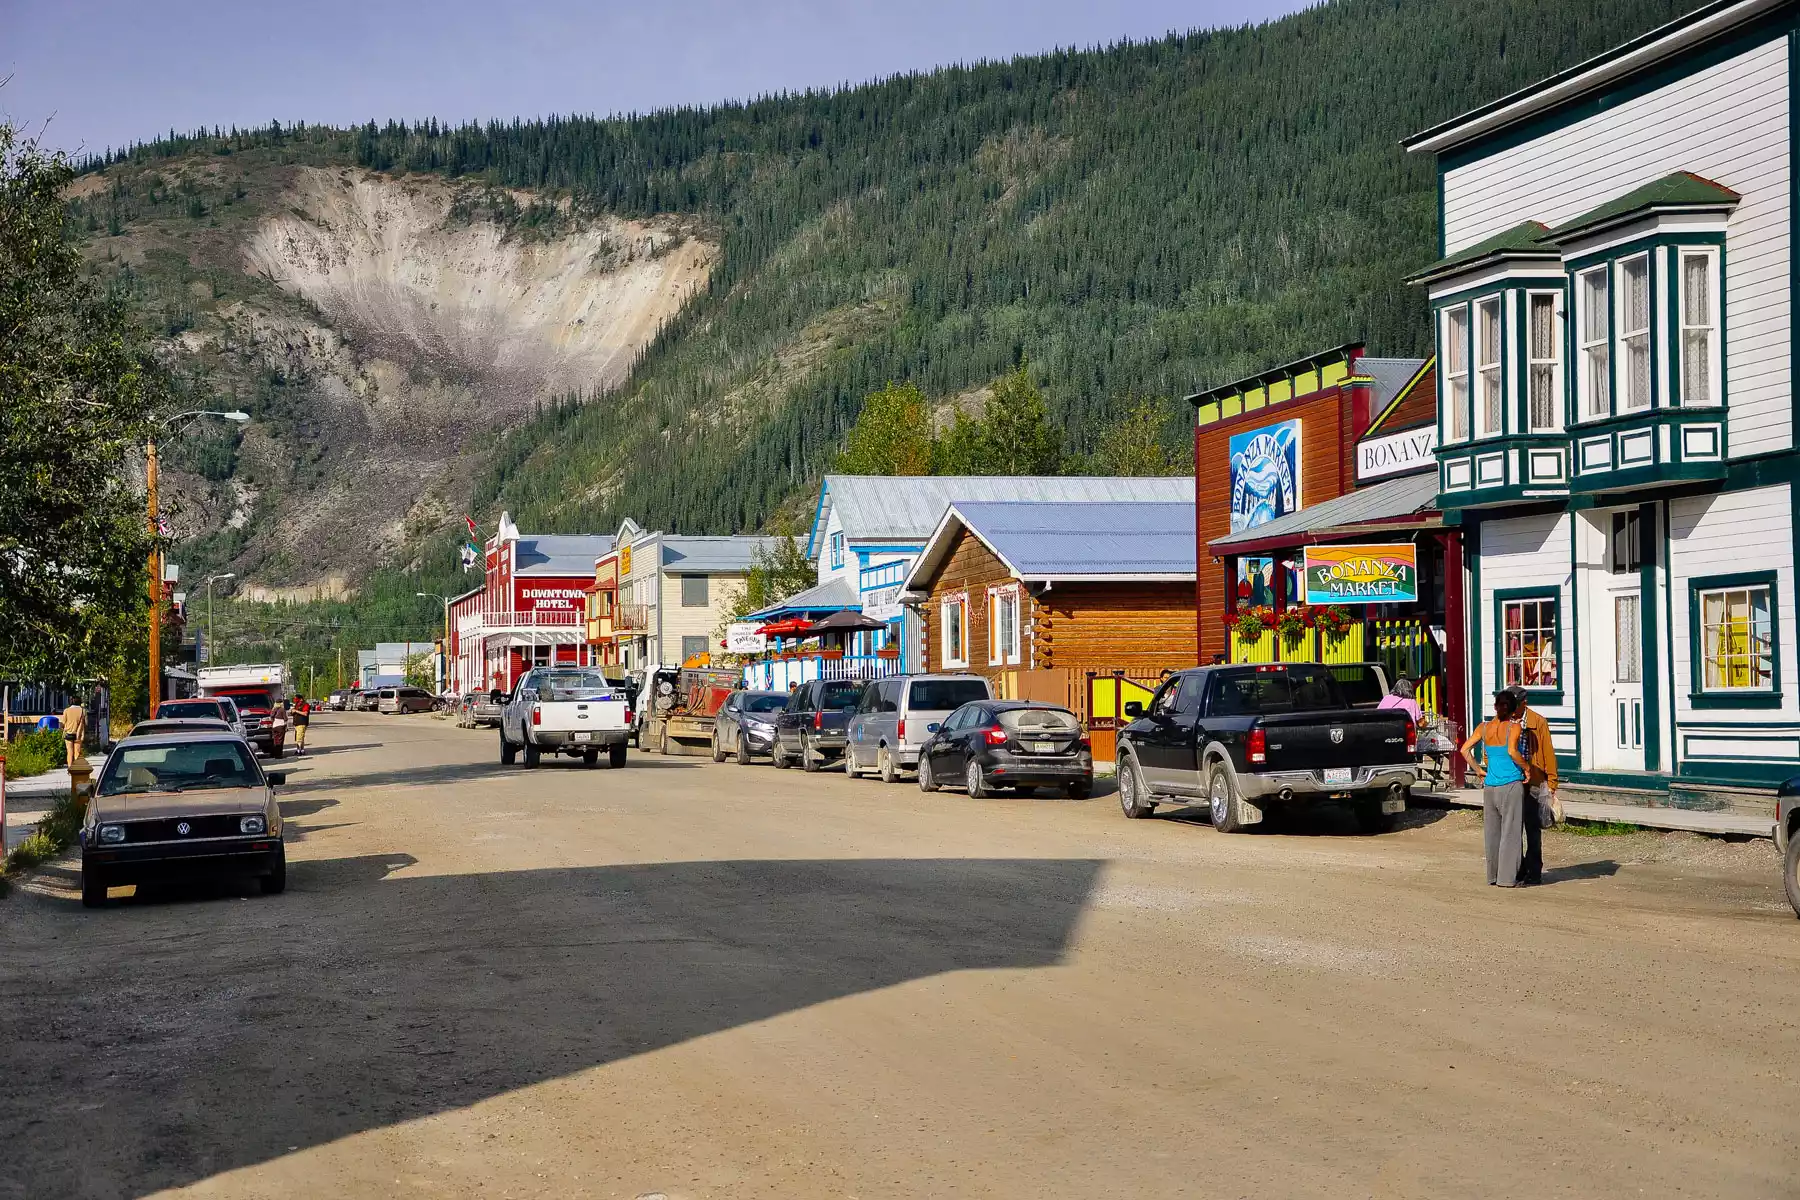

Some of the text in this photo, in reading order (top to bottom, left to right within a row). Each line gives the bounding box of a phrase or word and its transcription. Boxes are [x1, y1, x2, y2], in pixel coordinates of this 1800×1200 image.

[1364, 433, 1436, 470] BONANZ
[1234, 436, 1292, 513] BONANZA MARKET
[522, 589, 586, 598] DOWNTOWN
[1316, 560, 1406, 597] BONANZA MARKET
[535, 599, 573, 608] HOTEL
